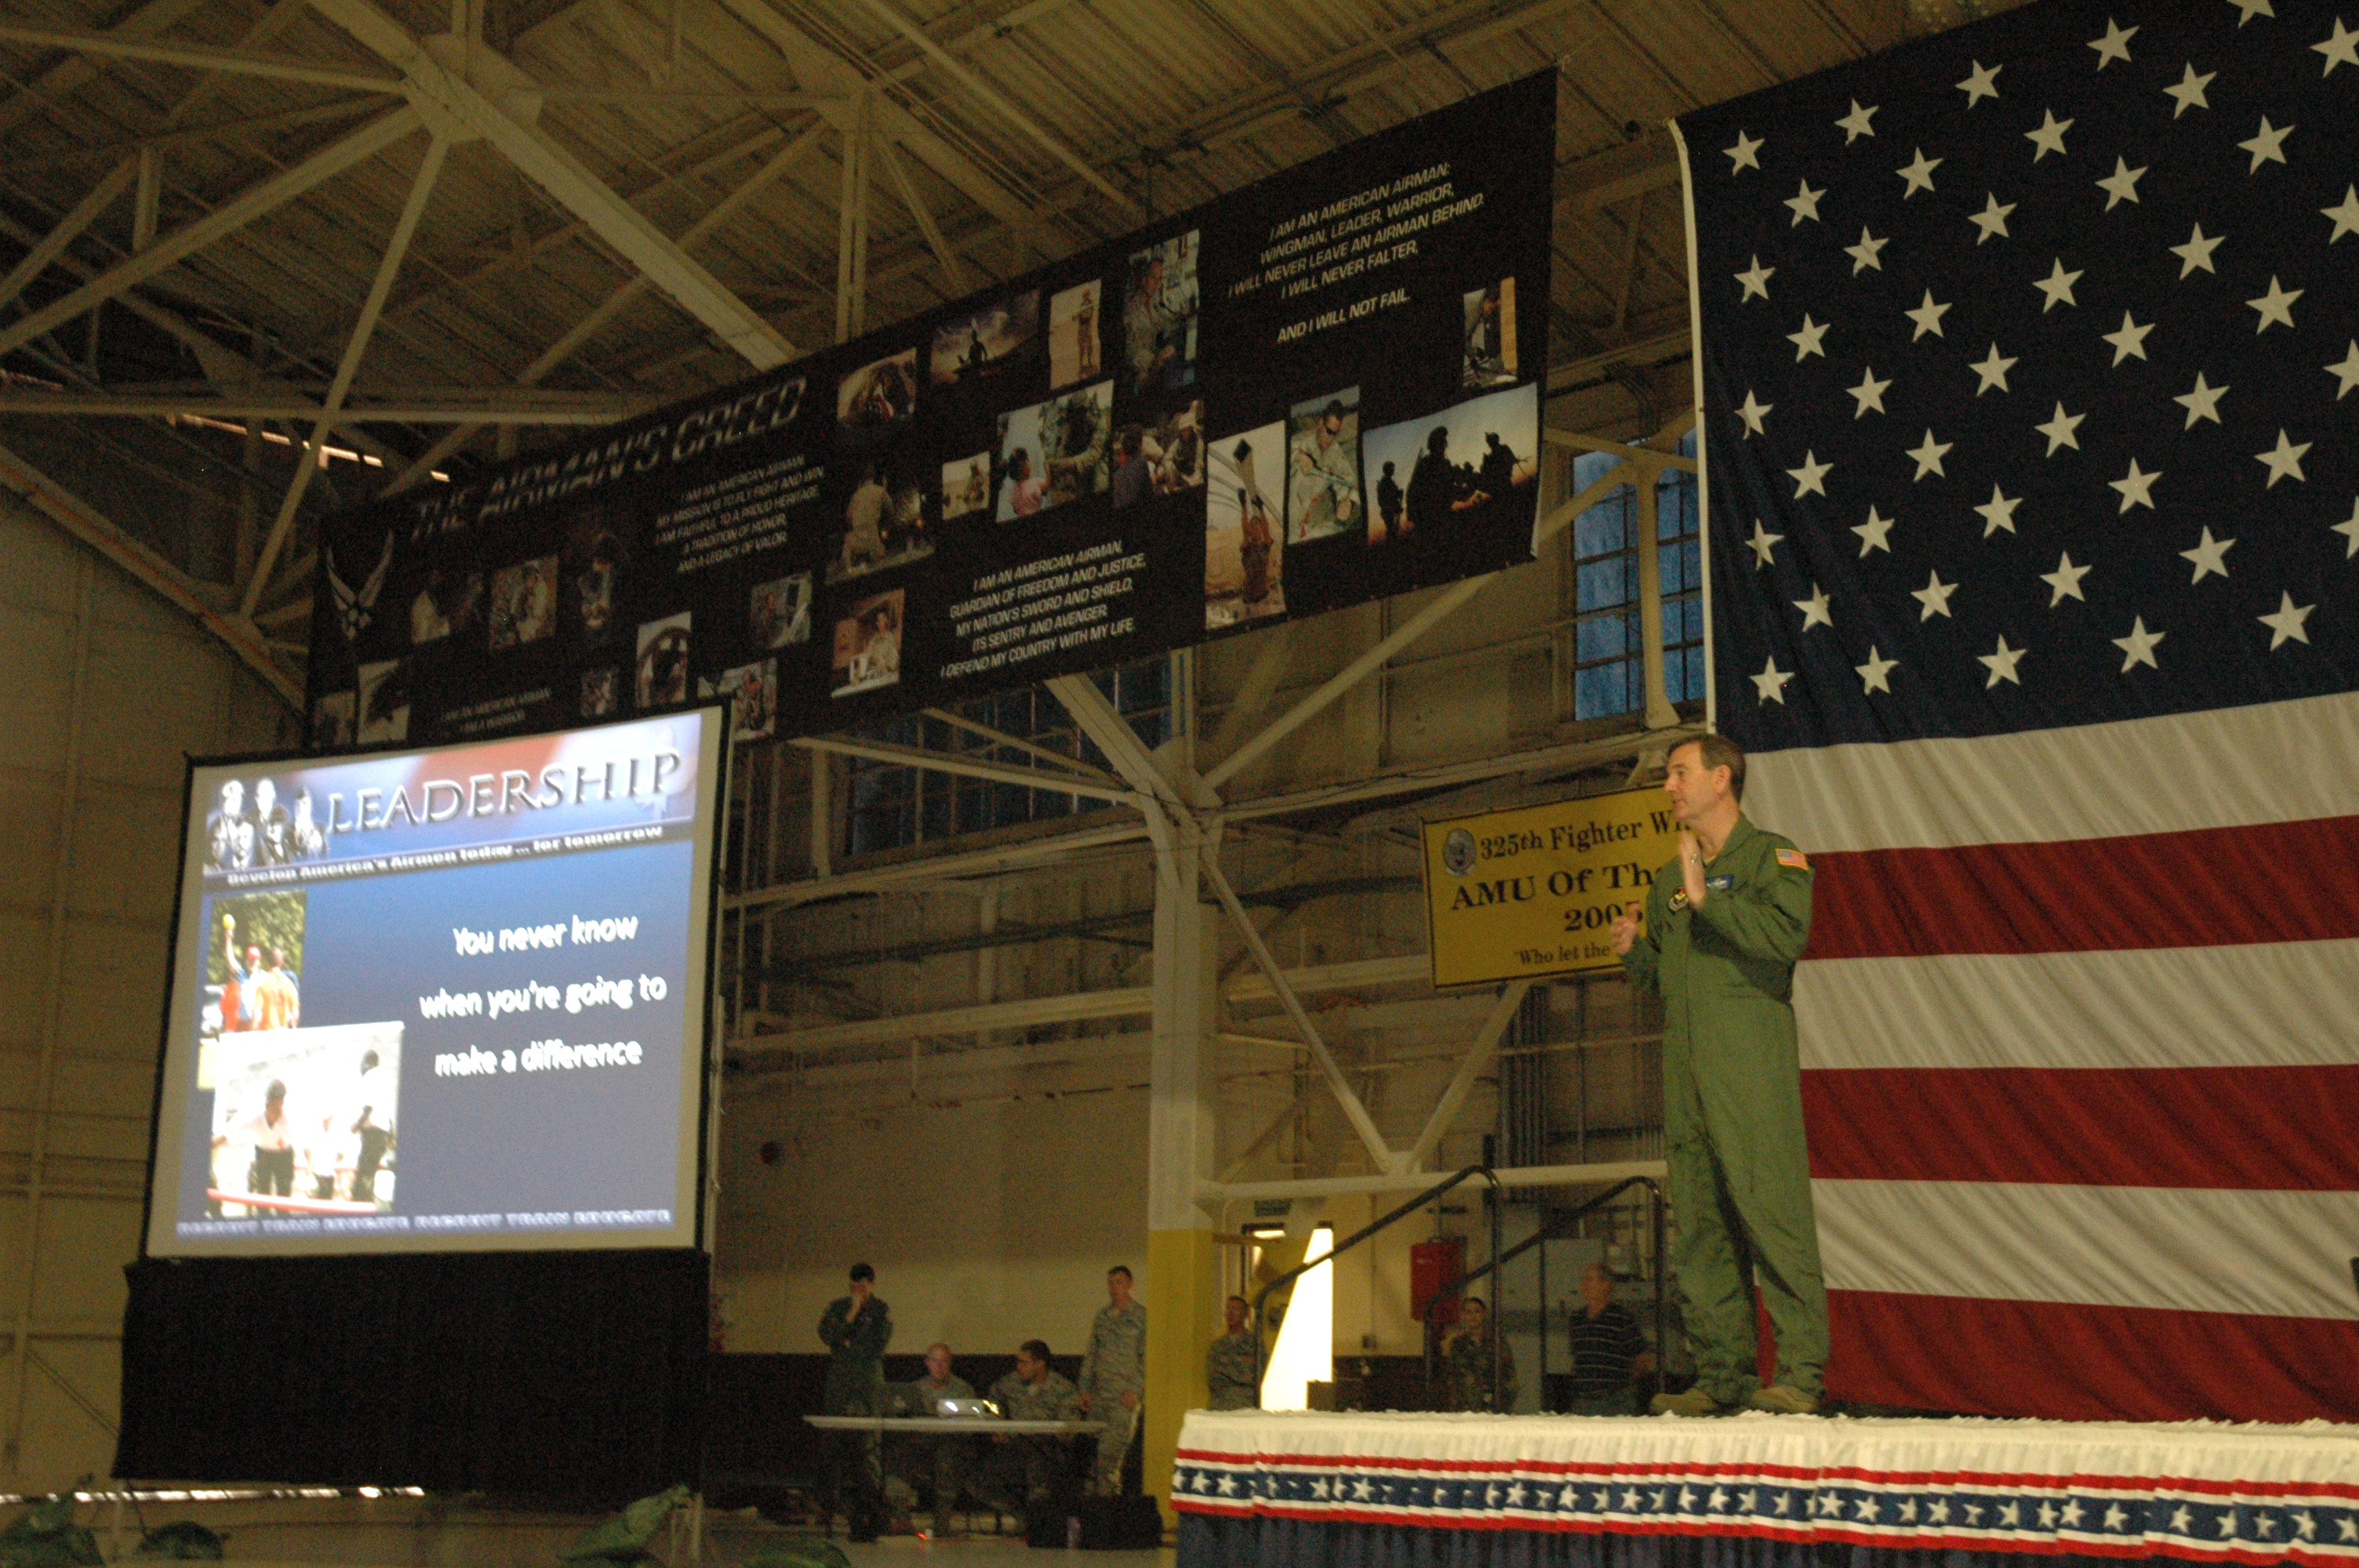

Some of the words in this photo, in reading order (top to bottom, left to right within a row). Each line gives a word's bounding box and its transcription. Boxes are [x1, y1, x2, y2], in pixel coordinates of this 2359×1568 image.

[1269, 227, 1274, 241] I
[1275, 219, 1296, 237] AM
[1298, 210, 1318, 229] AN
[1320, 183, 1390, 221] AMERICAN
[1228, 285, 1233, 298] I
[1235, 274, 1261, 296] WILL
[1265, 257, 1307, 283] NEVER
[1309, 241, 1349, 268] LEAVE
[1351, 234, 1371, 253] AN
[1373, 212, 1429, 245] AIRMAN
[1281, 285, 1286, 299] I
[1289, 275, 1318, 297] WILL
[1321, 257, 1365, 285] NEVER
[1277, 323, 1307, 344] AND
[1308, 318, 1314, 333] I
[1316, 308, 1347, 328] WILL
[1349, 298, 1379, 320] NOT
[1379, 287, 1411, 310] FAIL.
[950, 594, 1001, 619] GUARDIAN
[1002, 588, 1018, 604] OF
[1018, 573, 1070, 598] FREEDOM
[1070, 566, 1097, 584] AND
[979, 574, 998, 590] AM
[998, 570, 1013, 586] AN
[1014, 553, 1075, 580] AMERICAN
[956, 622, 972, 637] MY
[1022, 595, 1062, 619] SWORD
[1064, 588, 1090, 607] AND
[988, 623, 1027, 648] SENTRY
[1029, 616, 1053, 636] AND
[947, 655, 990, 677] DEFEND
[990, 651, 1008, 668] MY
[1009, 637, 1057, 663] COUNTRY
[1059, 628, 1089, 649] WITH
[1090, 624, 1109, 644] MY
[328, 749, 682, 833] LEADERSHIP
[227, 869, 298, 887] Develop
[300, 858, 387, 879] America's
[390, 850, 457, 869] Airmen
[460, 843, 514, 862] today
[533, 839, 562, 854] for
[565, 826, 663, 851] tomorrow
[1481, 830, 1544, 860] 325th
[1550, 821, 1642, 853] Fighter
[1452, 875, 1536, 910] AMU
[1547, 868, 1594, 897] Of
[1602, 862, 1662, 889] Th
[453, 927, 495, 956] You
[499, 922, 568, 953] never
[572, 913, 639, 946] know
[1558, 945, 1579, 961] let
[1584, 941, 1612, 958] the
[419, 987, 483, 1019] when
[487, 979, 562, 1020] you're
[565, 975, 635, 1014] going
[638, 973, 668, 1002] to
[434, 1044, 499, 1077] make
[501, 1049, 518, 1074] a
[521, 1038, 643, 1073] difference
